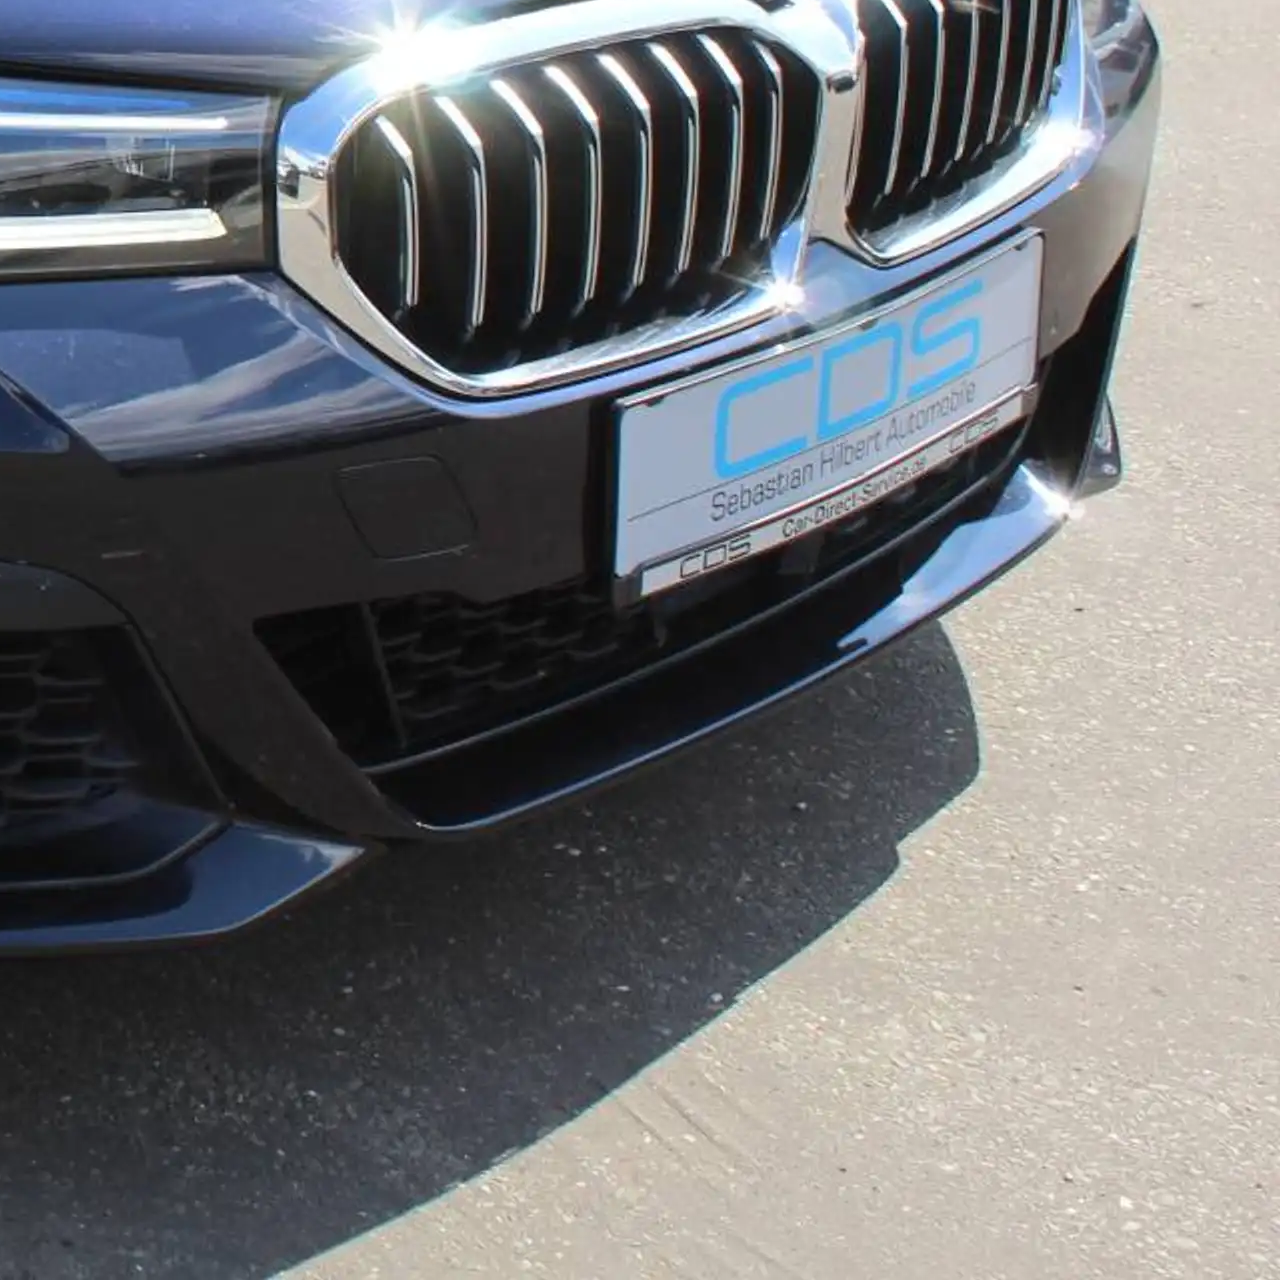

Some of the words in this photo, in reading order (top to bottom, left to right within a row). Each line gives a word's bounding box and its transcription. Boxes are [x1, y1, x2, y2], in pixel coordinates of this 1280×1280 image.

[710, 463, 814, 522] Sebastian
[820, 429, 881, 478] Hilbert
[886, 380, 976, 450] Automobile
[714, 279, 983, 479] CDS
